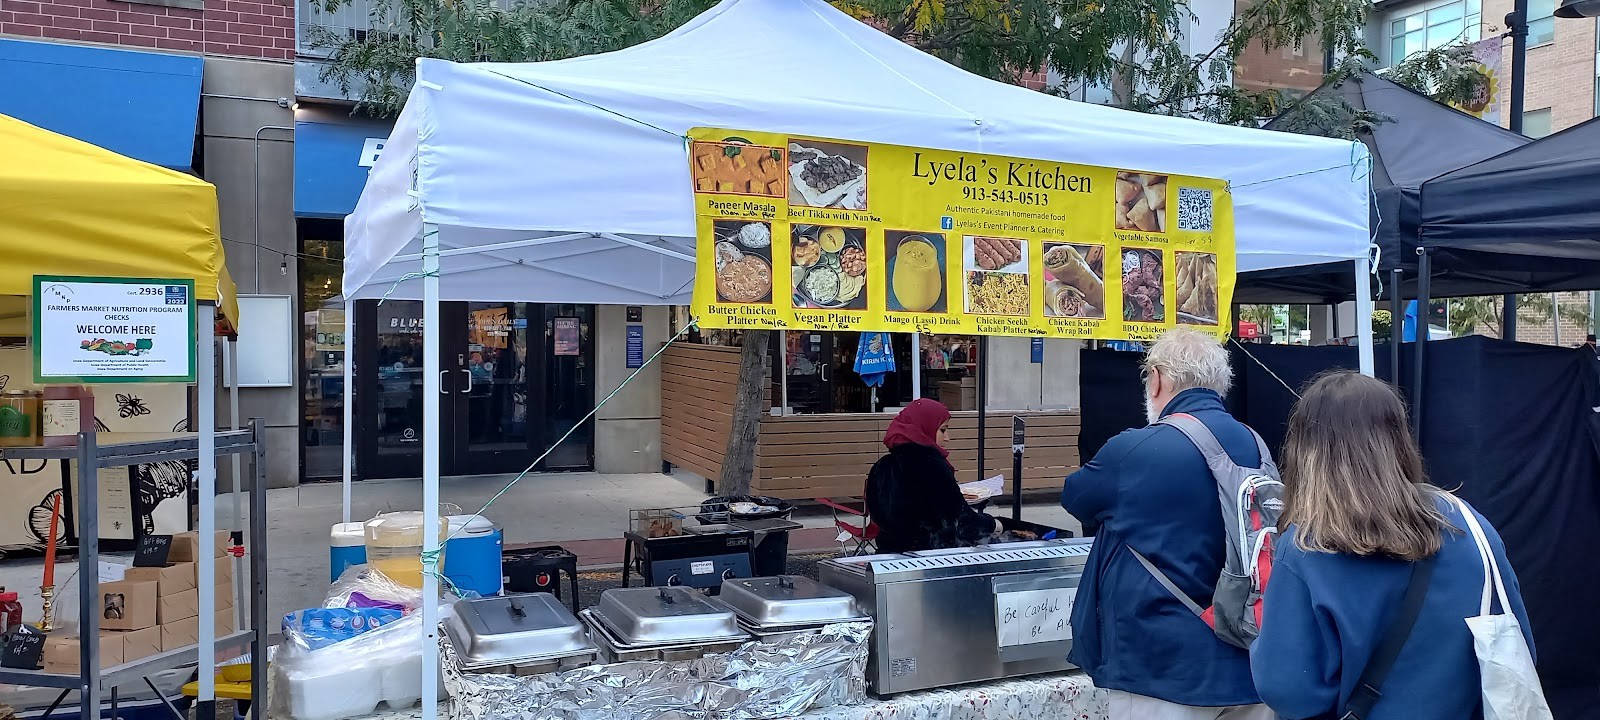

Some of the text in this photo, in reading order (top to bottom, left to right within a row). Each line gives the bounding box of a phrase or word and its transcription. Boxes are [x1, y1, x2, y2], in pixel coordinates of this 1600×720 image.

[912, 152, 1093, 193] Lyela's Kitchen
[962, 186, 1049, 206] 913-543-0513
[708, 200, 776, 212] Paneer Masala
[788, 208, 869, 222] Beef Tikka with Nan
[946, 204, 1066, 222] Authentic Pakistani homemade food
[983, 221, 1002, 230] Event
[1003, 222, 1029, 232] Planner
[1038, 226, 1065, 236] Catering
[1114, 232, 1144, 242] Vegetable
[1145, 235, 1169, 244] Samosa
[139, 287, 163, 296] 2936
[708, 305, 777, 315] Butter Chicken
[727, 316, 758, 326] Platter
[794, 312, 862, 324] Vegan Platter
[884, 315, 961, 326] Mango (Lassi) Drink
[976, 317, 1028, 326] Chicken Seekh
[1048, 318, 1076, 327] Chicken
[76, 324, 156, 335] WELCOME HERE
[977, 324, 1027, 334] Kabab Platter
[1057, 327, 1077, 336] Wrap
[1122, 325, 1167, 333] BBQ Chicken
[862, 358, 880, 366] KIRIN
[1004, 607, 1017, 624] Be
[1032, 626, 1042, 637] Be
